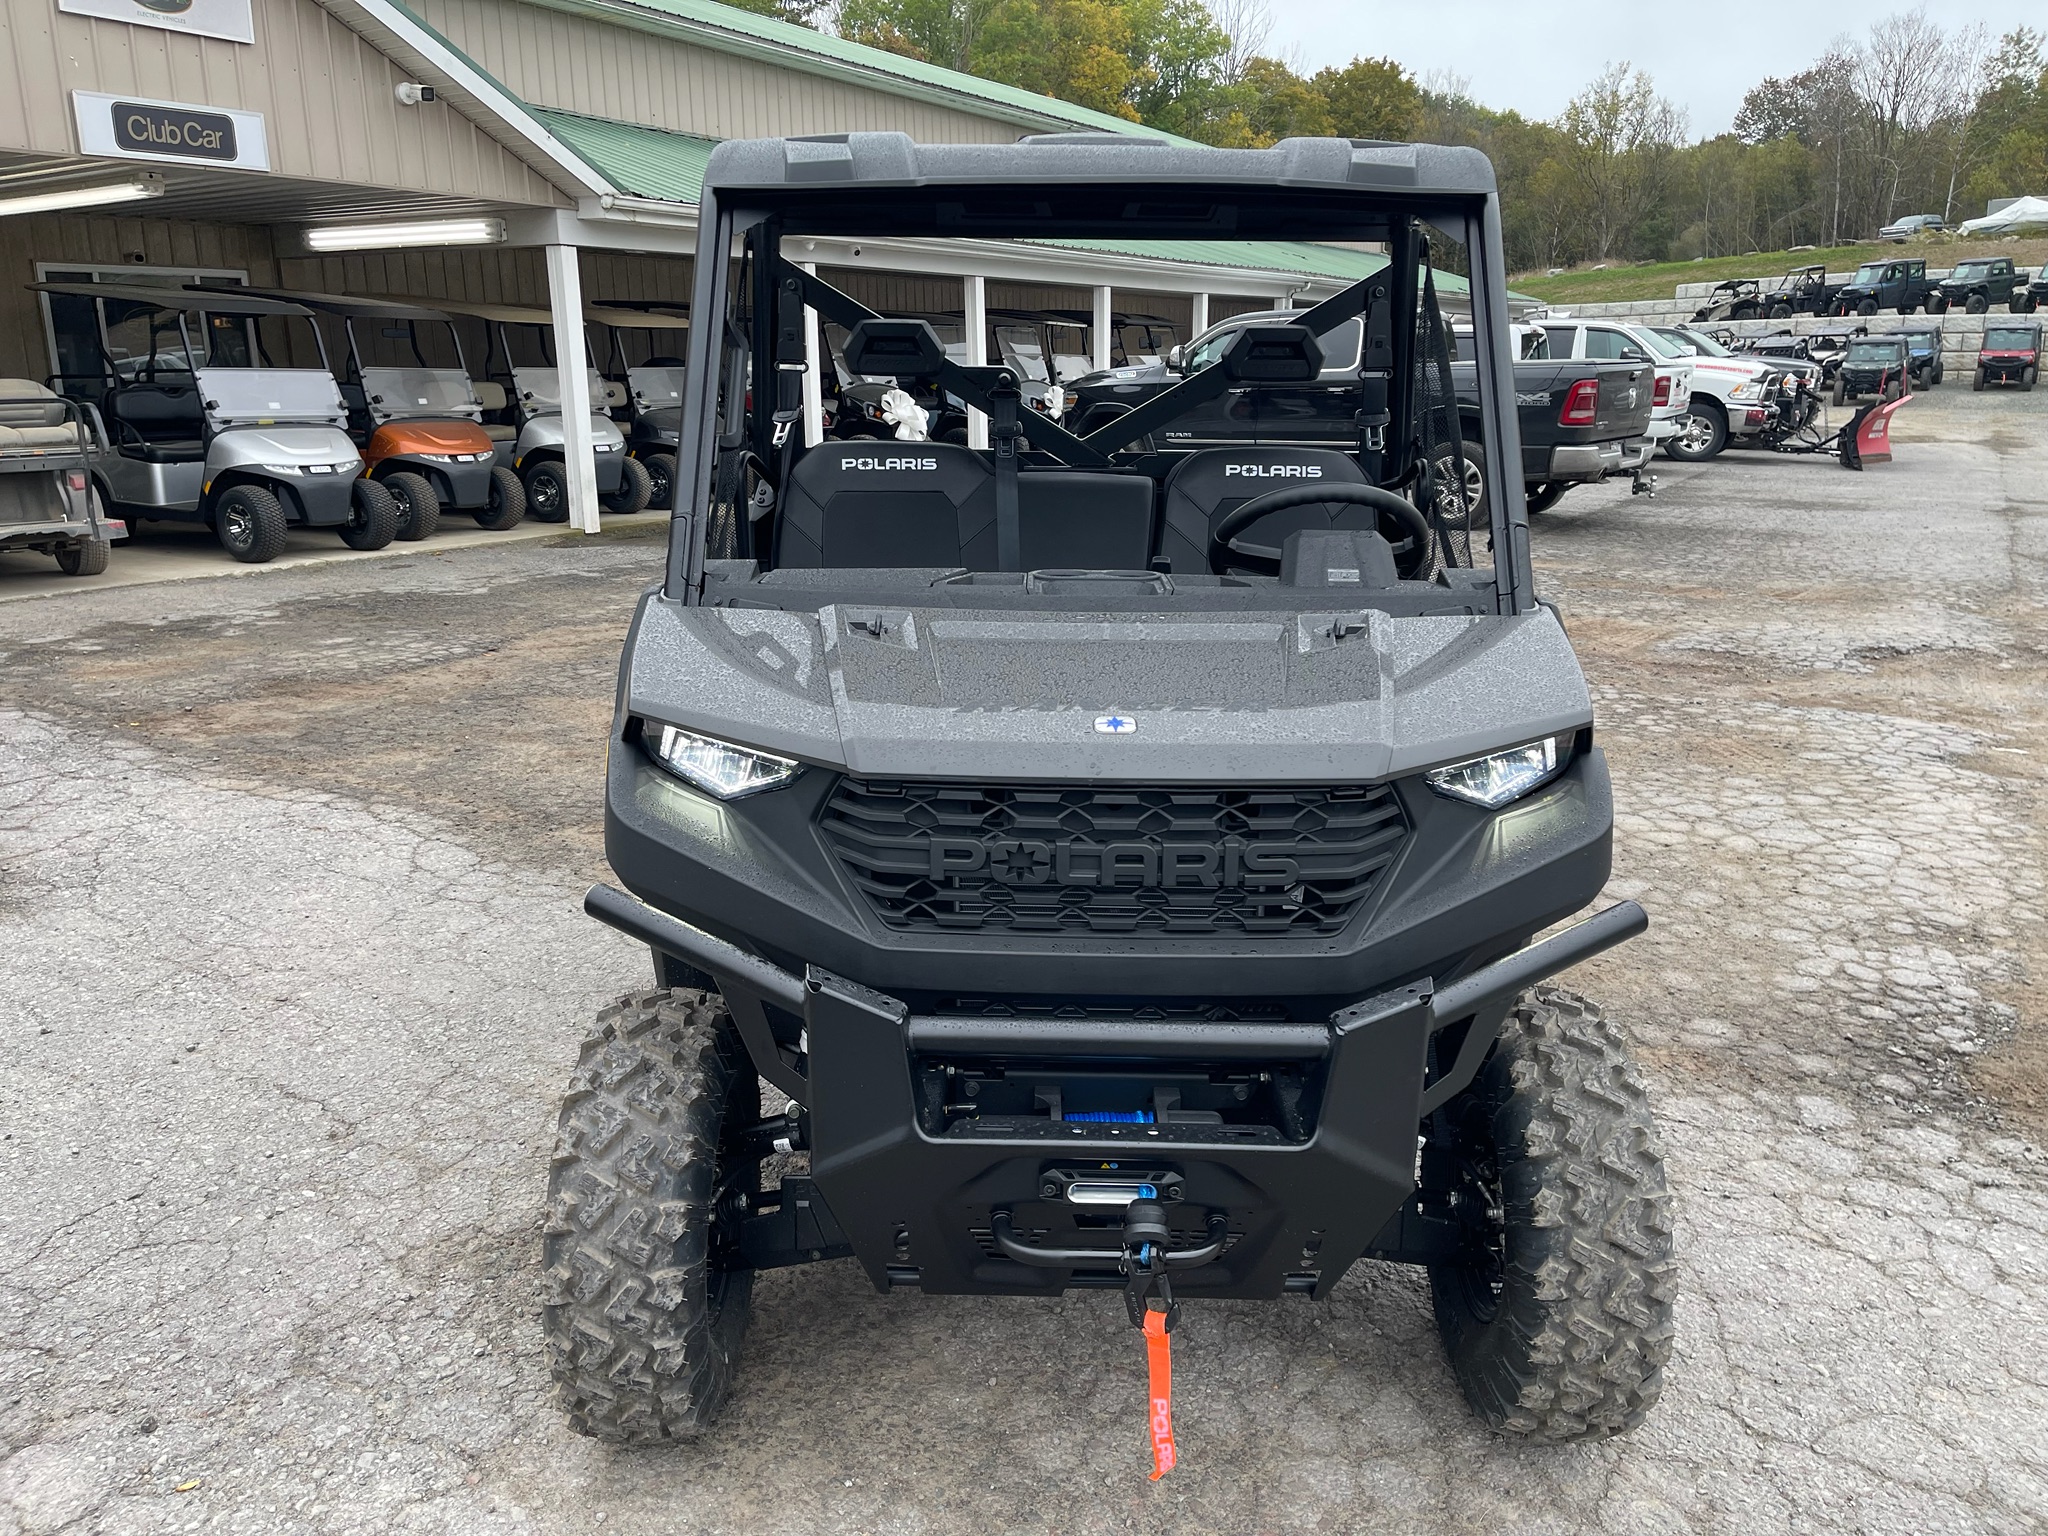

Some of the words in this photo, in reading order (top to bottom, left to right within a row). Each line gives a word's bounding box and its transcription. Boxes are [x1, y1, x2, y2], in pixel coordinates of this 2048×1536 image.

[136, 10, 160, 20] ELECTRIC
[162, 15, 186, 24] VEHICLES
[127, 115, 181, 145] Club
[183, 121, 223, 149] Car
[841, 458, 937, 470] POLARIS
[1225, 464, 1323, 478] POLARIS
[930, 837, 1301, 887] POLARIS
